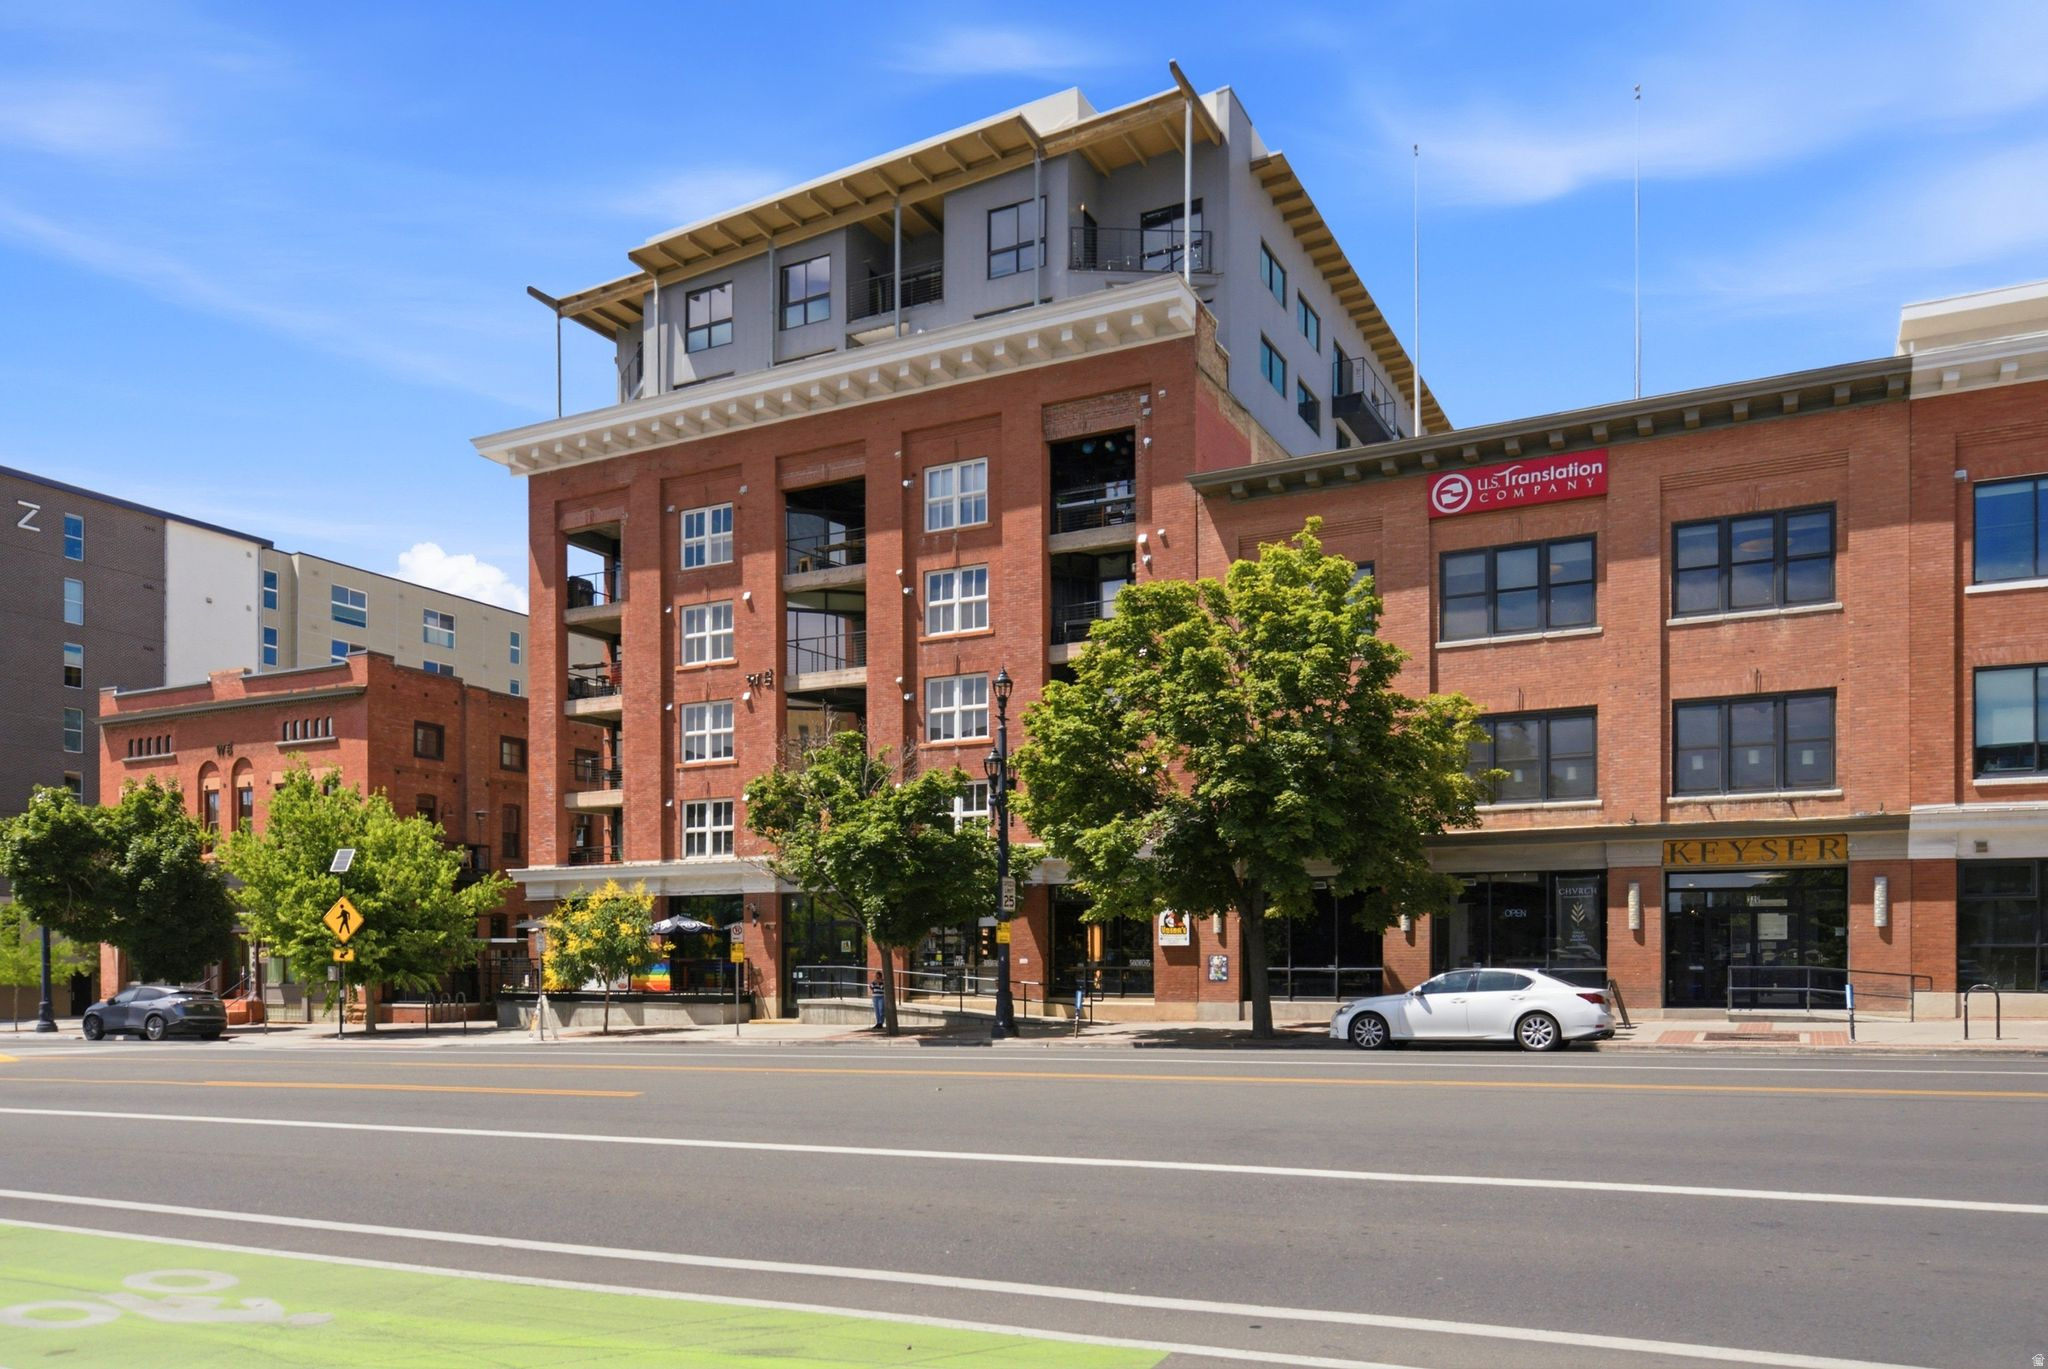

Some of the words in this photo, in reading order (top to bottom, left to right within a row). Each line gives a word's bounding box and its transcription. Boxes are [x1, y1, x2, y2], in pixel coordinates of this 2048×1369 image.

[1494, 462, 1602, 487] Translation
[1479, 478, 1595, 503] COMPANY
[17, 500, 40, 532] Z
[1669, 837, 1841, 864] KEYSER
[1003, 894, 1014, 908] 25
[1504, 908, 1527, 918] OPEN
